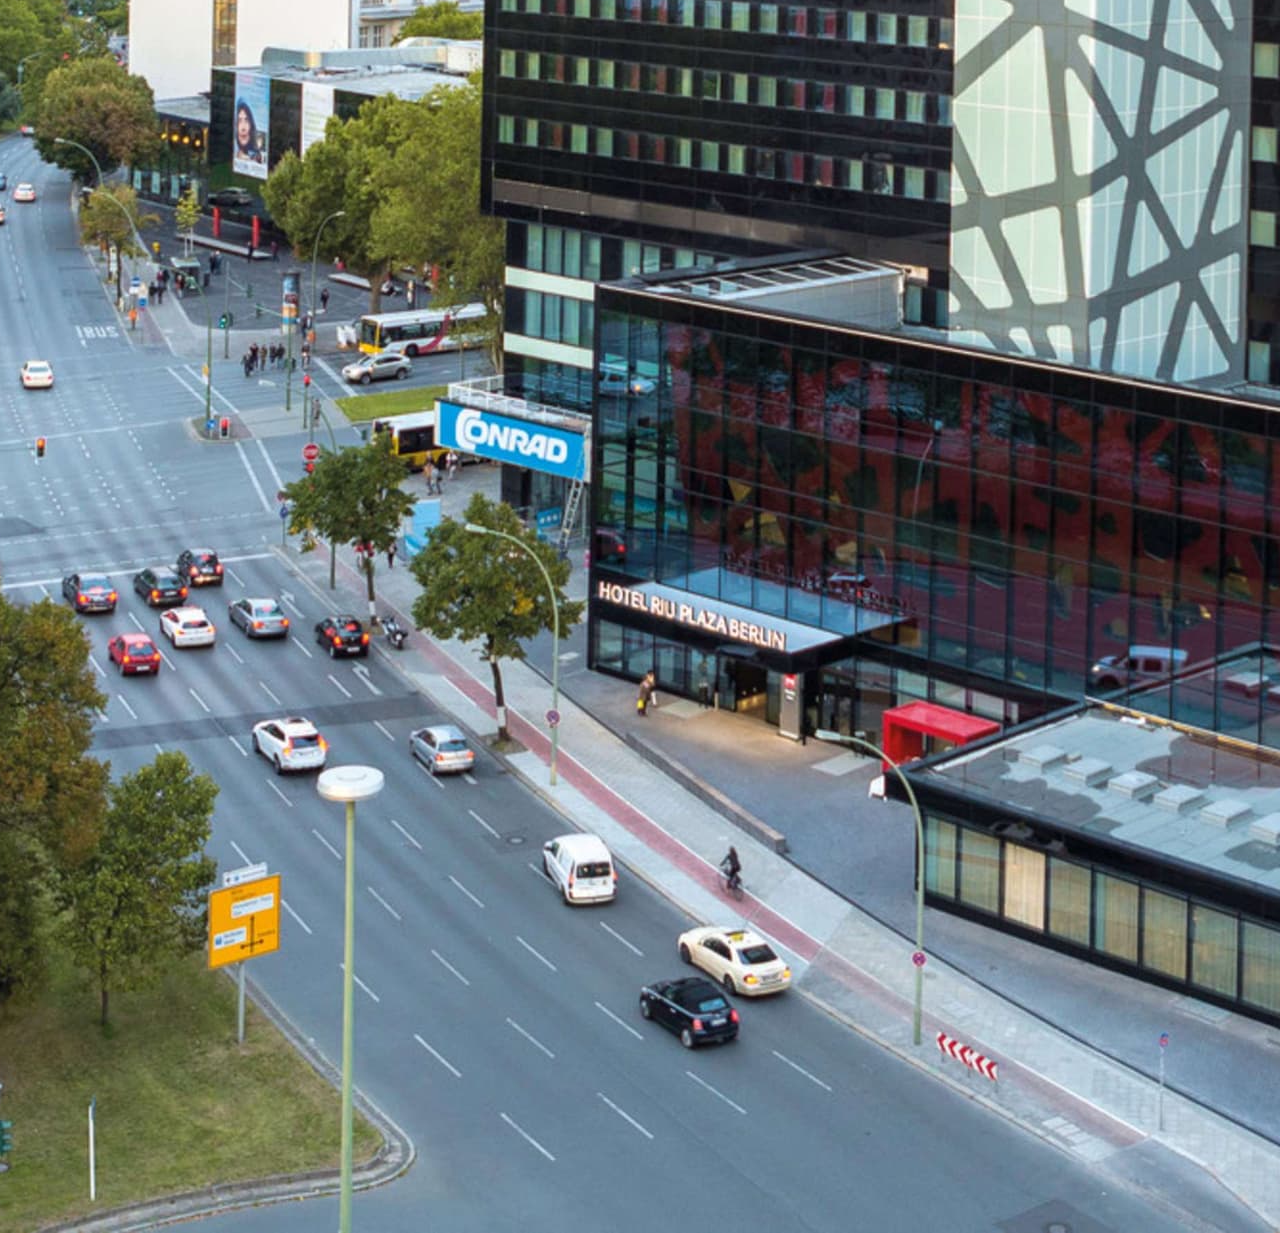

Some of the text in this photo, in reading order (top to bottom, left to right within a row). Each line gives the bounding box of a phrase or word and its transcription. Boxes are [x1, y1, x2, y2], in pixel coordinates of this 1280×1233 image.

[455, 408, 568, 464] CONRAD
[599, 581, 786, 650] HOTEL RIU PLAZA BERLIN
